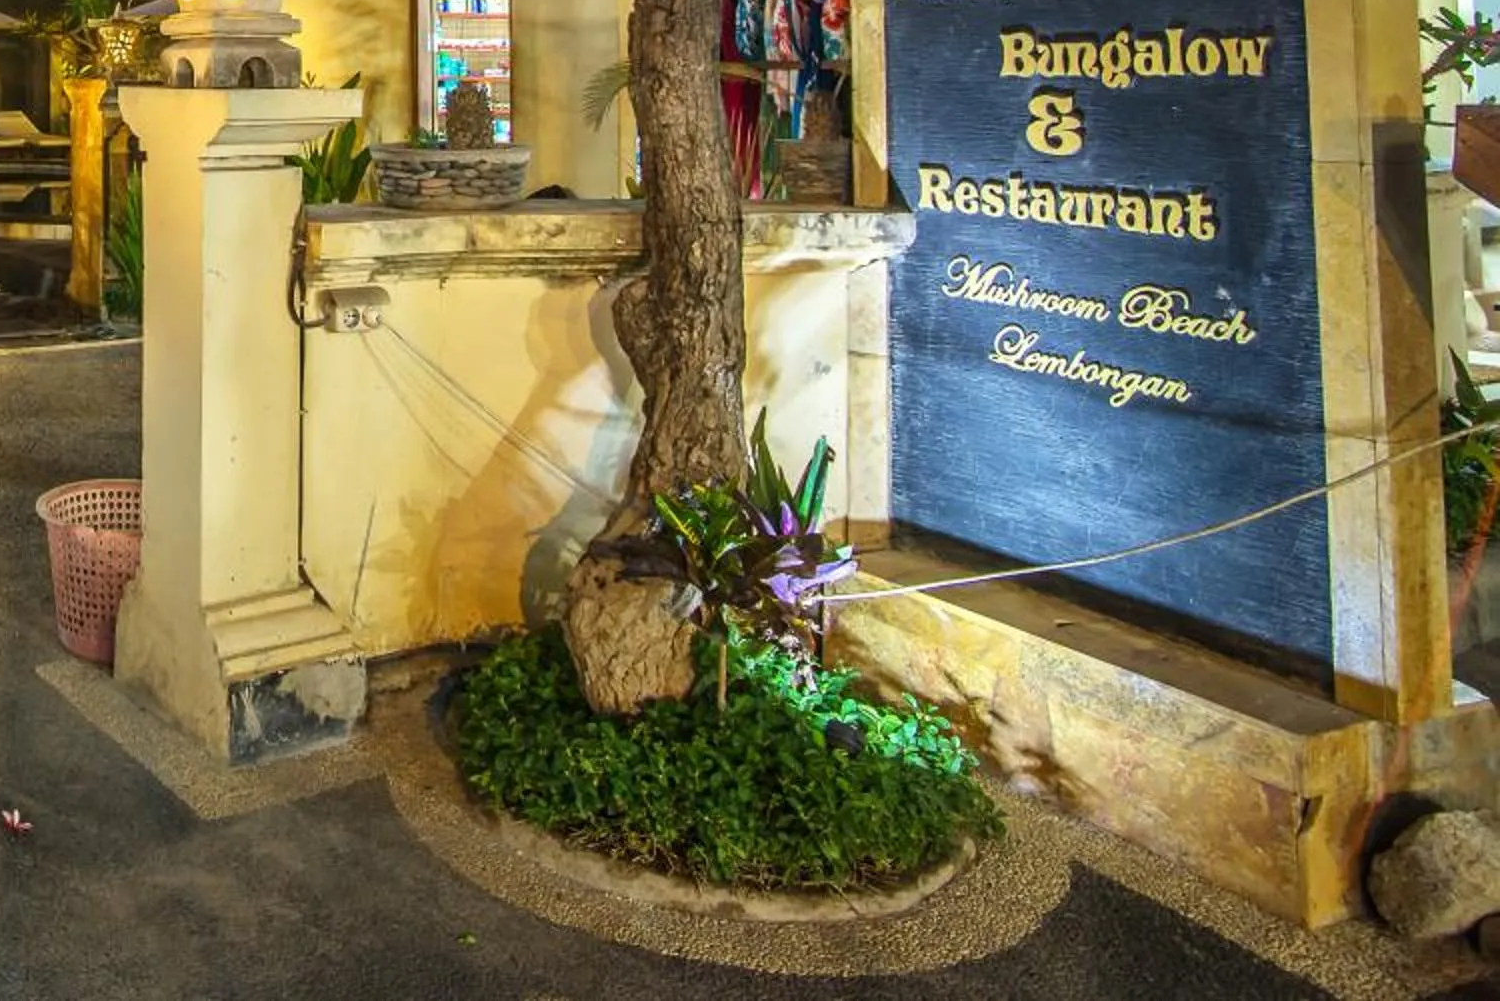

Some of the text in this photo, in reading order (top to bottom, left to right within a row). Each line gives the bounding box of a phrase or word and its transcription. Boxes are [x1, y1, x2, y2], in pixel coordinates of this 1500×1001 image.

[1000, 28, 1267, 88] Bungalow
[1025, 93, 1084, 156] &
[918, 168, 1215, 240] Restaurant
[942, 256, 1256, 344] Mushroom Beach
[988, 326, 1192, 407] Lembongan
